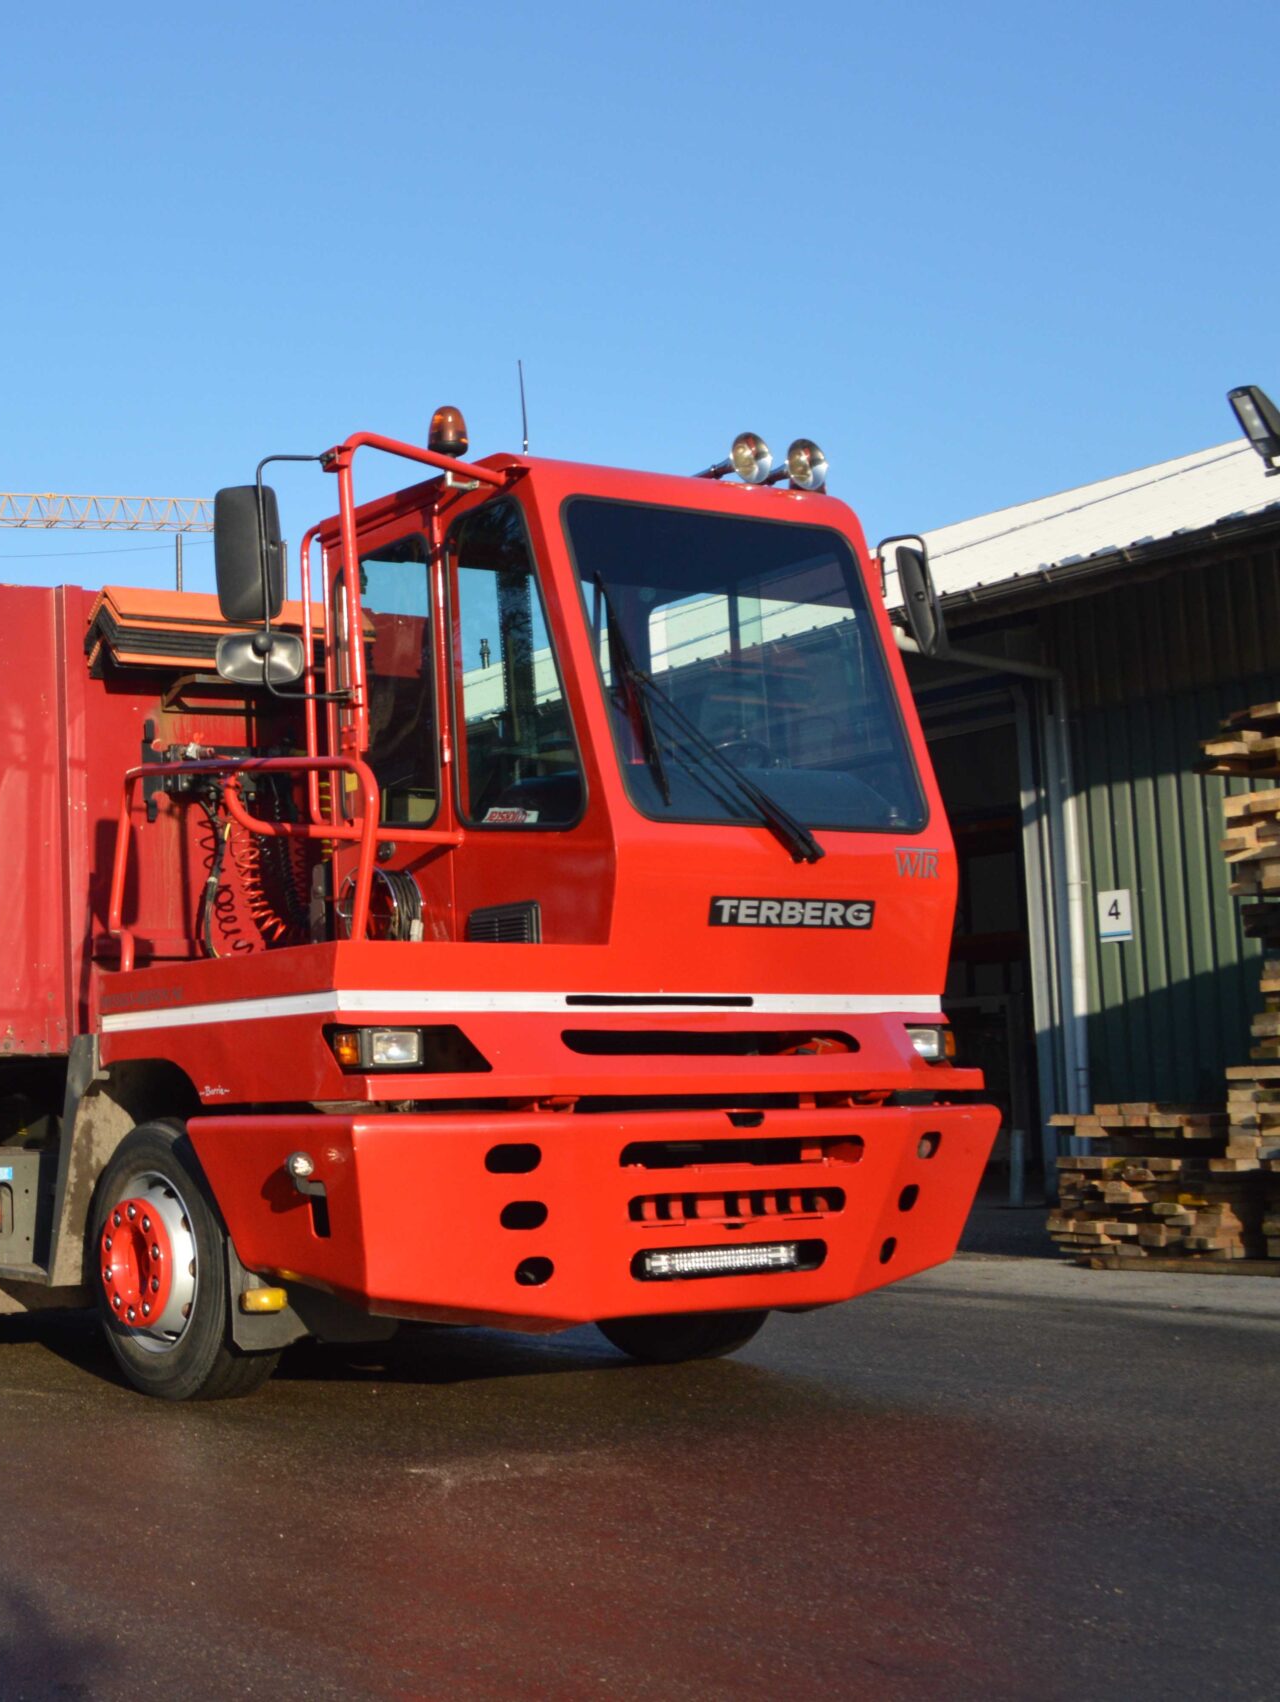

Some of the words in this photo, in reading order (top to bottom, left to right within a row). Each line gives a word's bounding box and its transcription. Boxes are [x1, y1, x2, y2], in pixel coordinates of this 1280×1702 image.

[894, 846, 939, 879] WTR
[715, 899, 872, 927] TERBERG
[1108, 899, 1121, 921] 4
